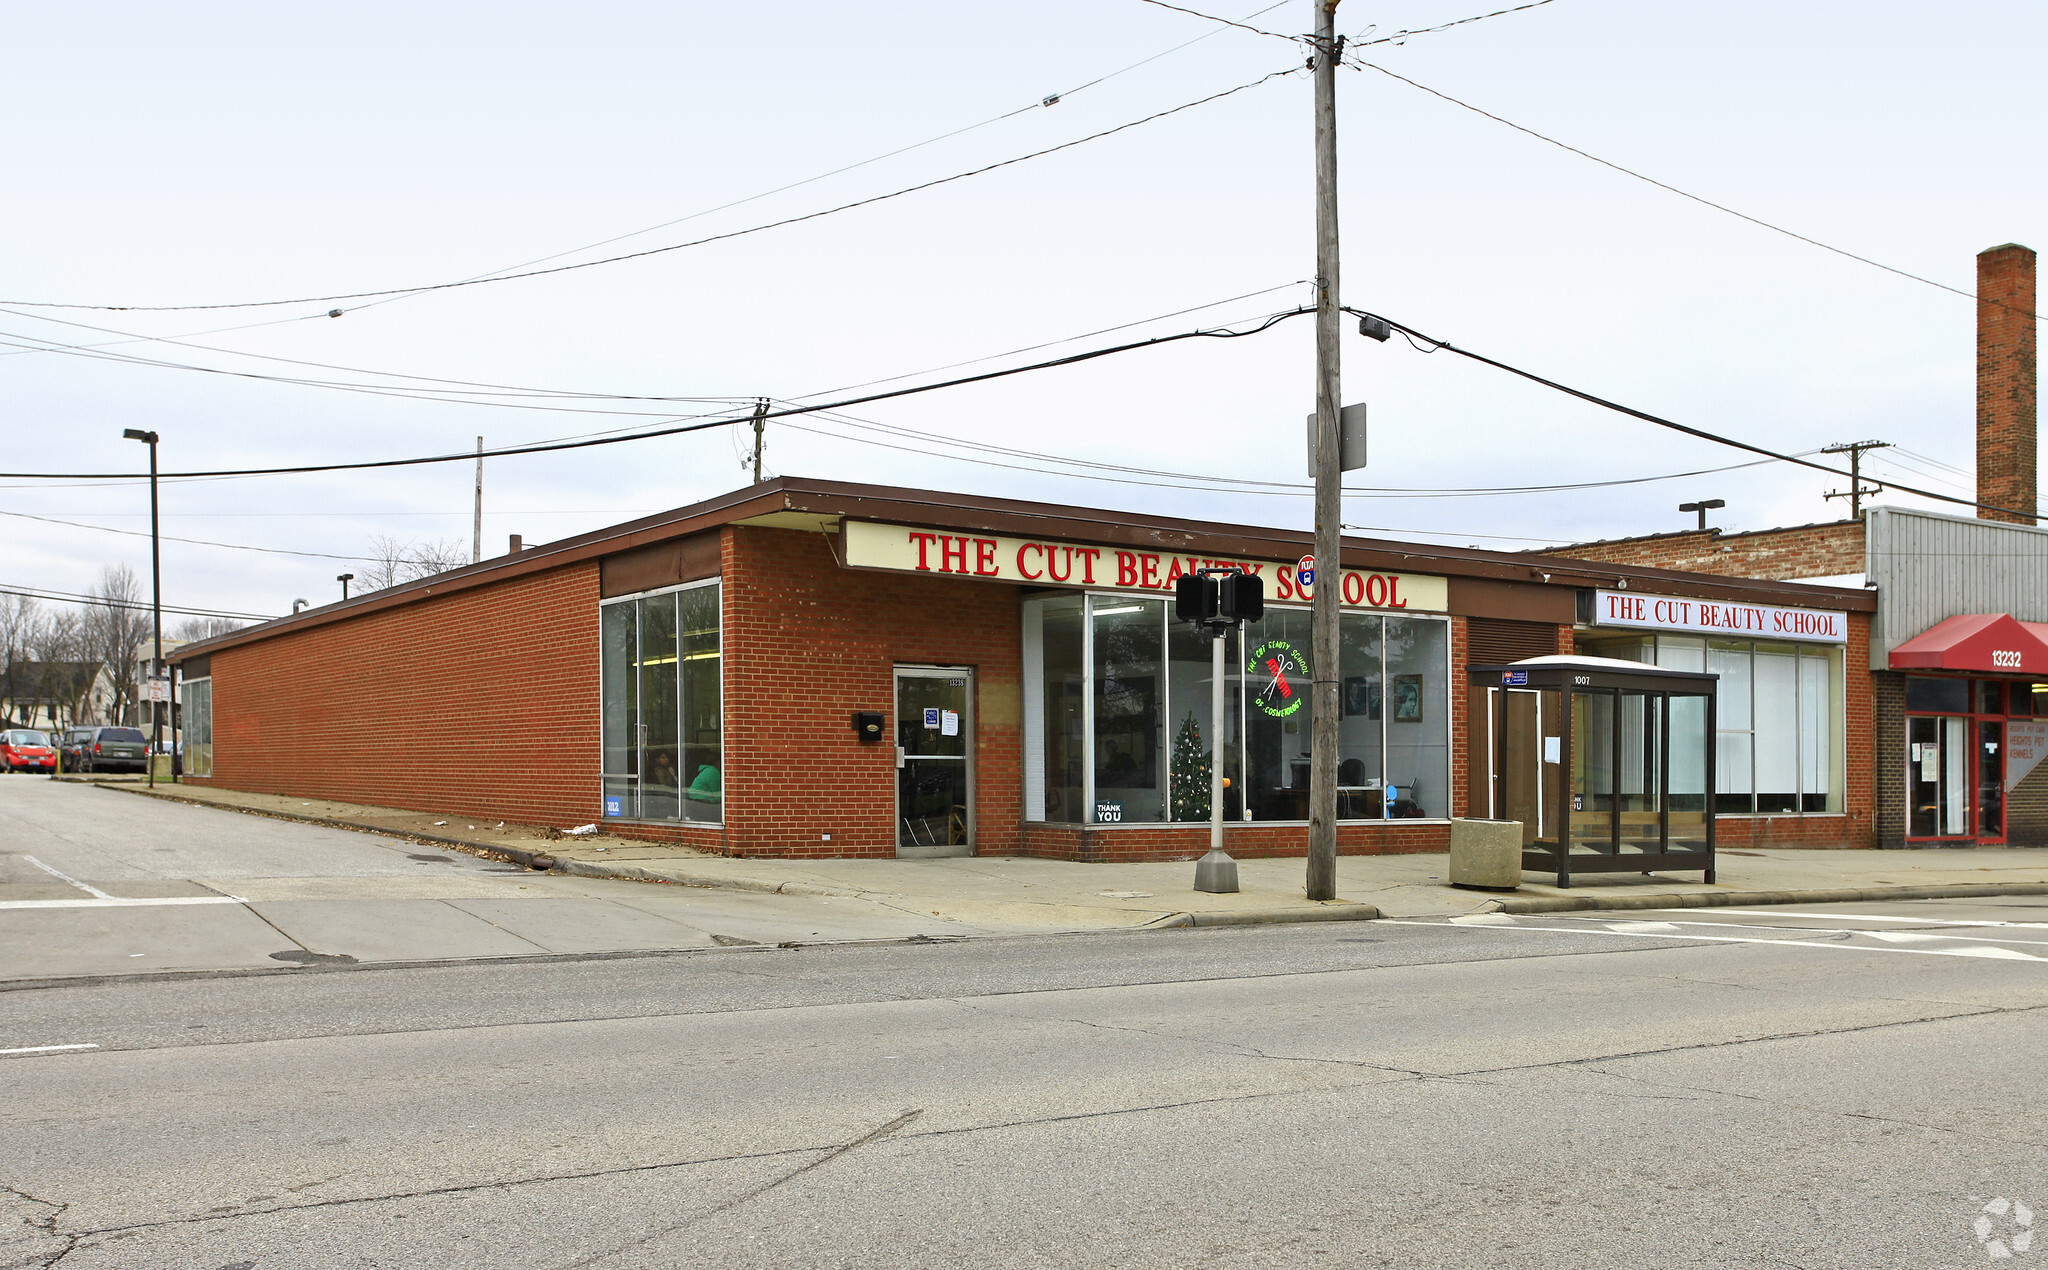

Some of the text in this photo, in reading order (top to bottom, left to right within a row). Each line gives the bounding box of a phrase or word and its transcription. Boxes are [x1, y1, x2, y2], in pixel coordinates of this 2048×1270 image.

[909, 532, 1000, 577] THE
[1016, 543, 1101, 582] CUT
[1277, 566, 1408, 608] SOOL
[1301, 561, 1314, 570] RTA
[1607, 595, 1839, 637] THE CUT BEAUTY SCHOOL
[1255, 644, 1266, 658] CUT
[1290, 649, 1309, 675] SCHOOL
[1992, 650, 2022, 667] 13232
[1574, 676, 1590, 685] 1007
[2009, 736, 2045, 747] HEIGHTS PET
[2009, 748, 2034, 760] KENNELS
[1097, 804, 1121, 812] THANK
[1097, 811, 1122, 822] YOU
